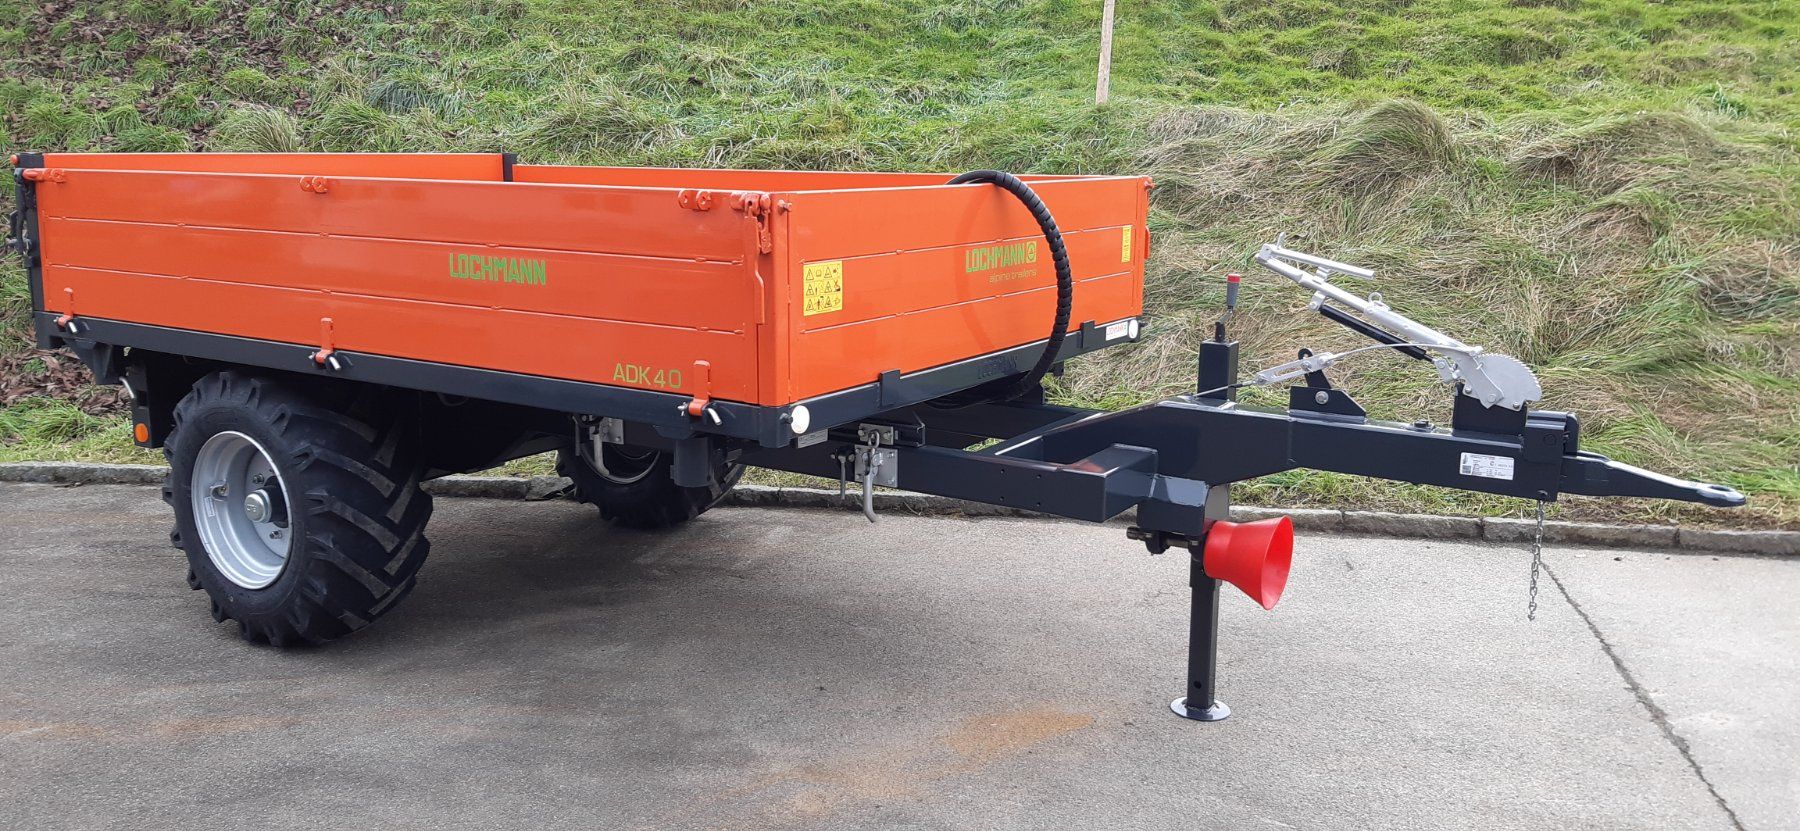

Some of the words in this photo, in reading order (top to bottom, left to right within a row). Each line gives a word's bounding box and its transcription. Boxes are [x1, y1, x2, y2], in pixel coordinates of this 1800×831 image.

[449, 252, 546, 286] LOCHMANN
[965, 243, 1025, 273] LOCHMANN
[613, 362, 651, 385] ADK
